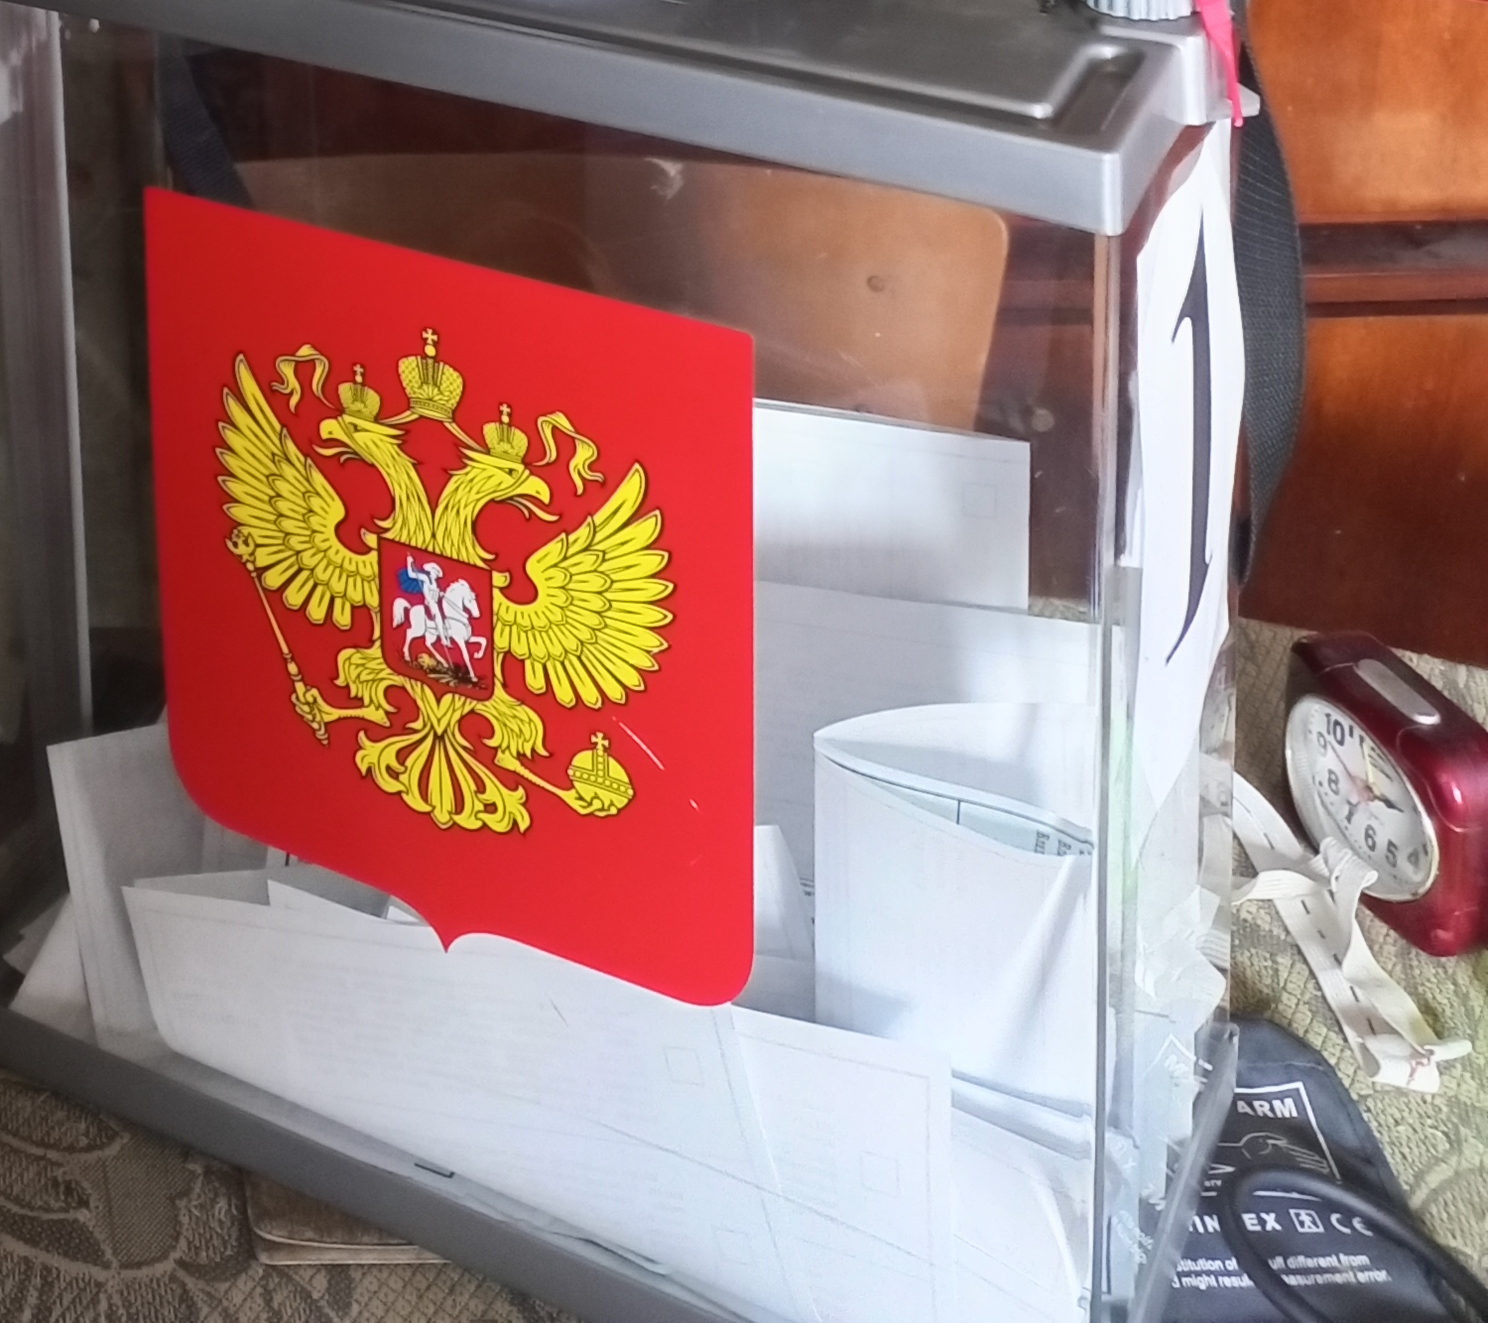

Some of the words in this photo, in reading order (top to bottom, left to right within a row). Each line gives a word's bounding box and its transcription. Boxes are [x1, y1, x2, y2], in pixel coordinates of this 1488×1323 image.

[1324, 713, 1346, 747] 10
[1316, 731, 1328, 758] 9
[1327, 768, 1340, 796] 8
[1364, 824, 1376, 853] 6
[1385, 838, 1399, 868] 5
[1236, 1097, 1298, 1119] ARM
[1285, 1254, 1340, 1269] different
[1338, 1253, 1371, 1268] from
[1180, 1273, 1218, 1290] might
